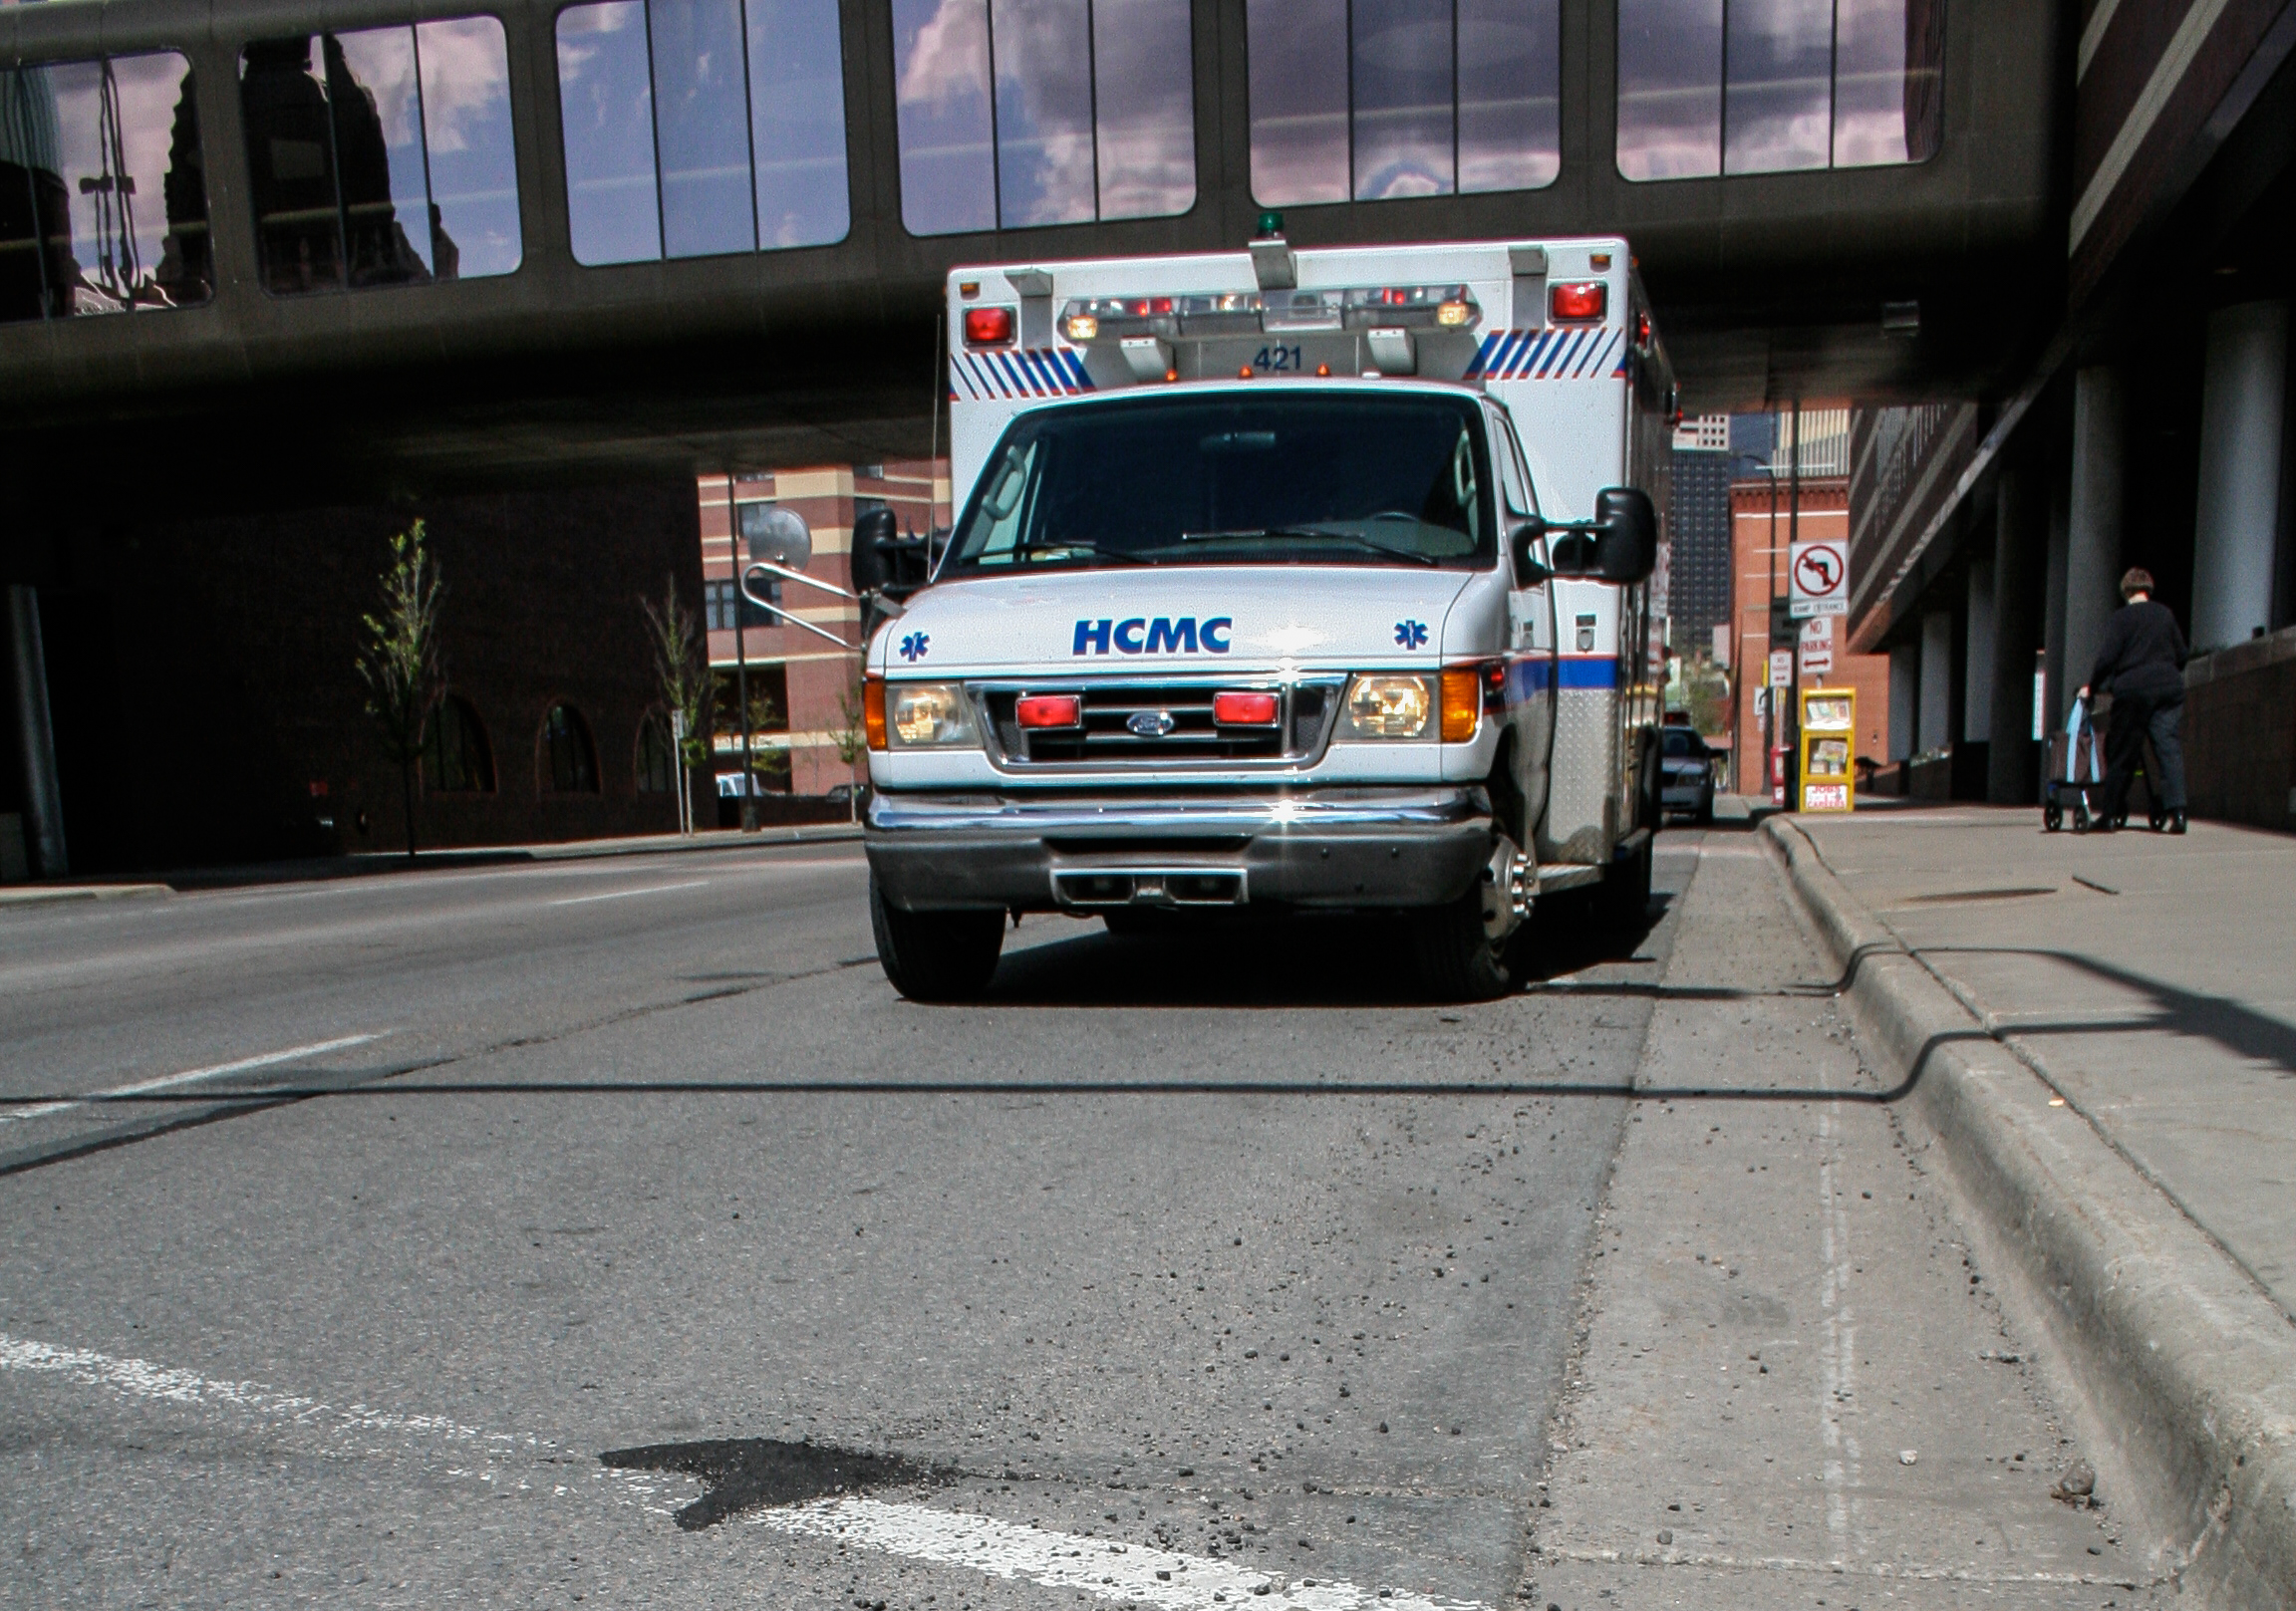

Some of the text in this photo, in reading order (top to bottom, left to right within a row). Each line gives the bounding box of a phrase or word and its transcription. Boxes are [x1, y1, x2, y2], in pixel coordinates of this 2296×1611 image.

[1254, 345, 1301, 371] 421
[1072, 617, 1233, 656] HCMC
[1810, 620, 1823, 635] NO
